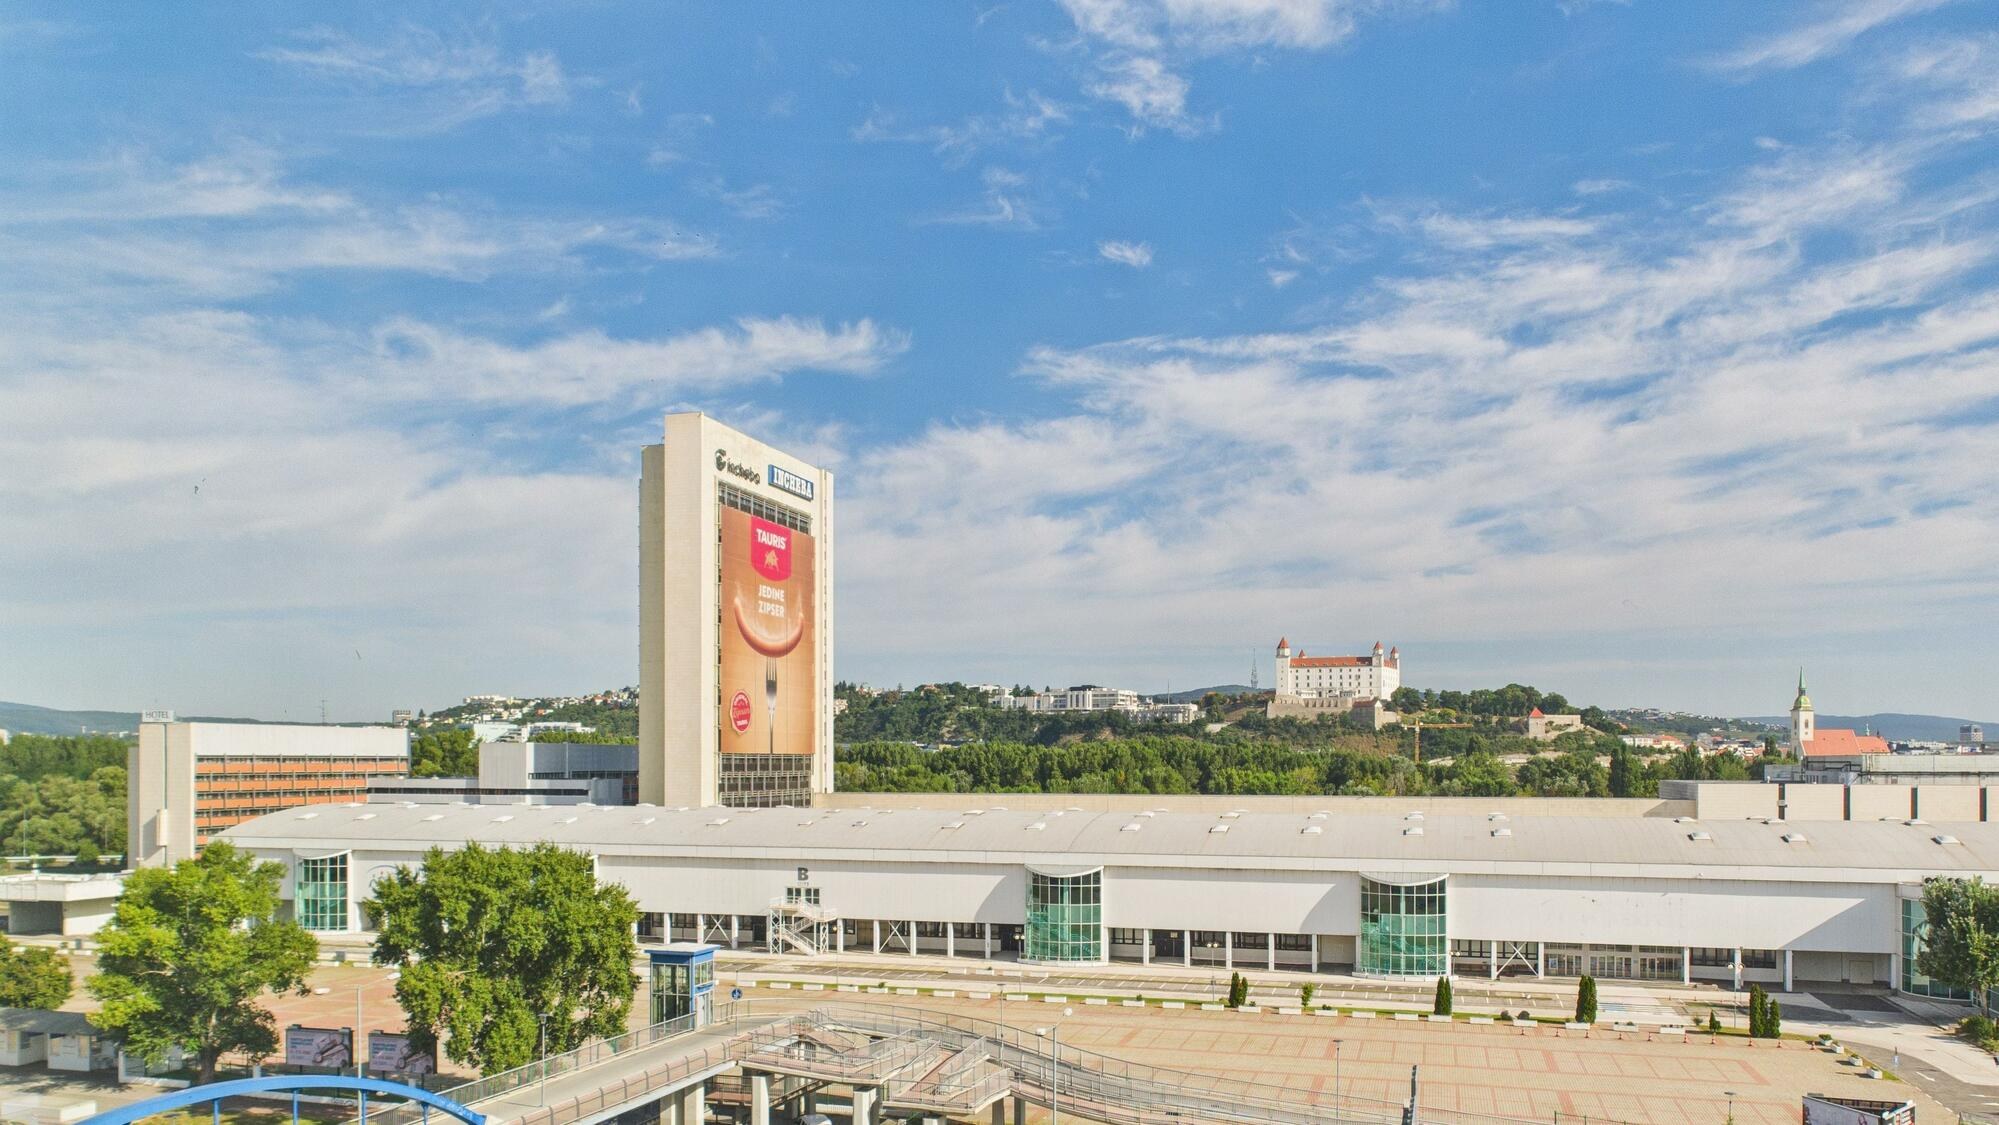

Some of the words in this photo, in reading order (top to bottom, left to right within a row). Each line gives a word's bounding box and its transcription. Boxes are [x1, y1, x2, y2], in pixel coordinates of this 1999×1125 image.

[773, 467, 812, 499] INCHEBA
[756, 528, 786, 550] TAURIS
[758, 584, 785, 602] JEDINE
[758, 601, 785, 618] ZIPSER
[145, 710, 169, 719] HOTEL
[797, 867, 809, 881] B
